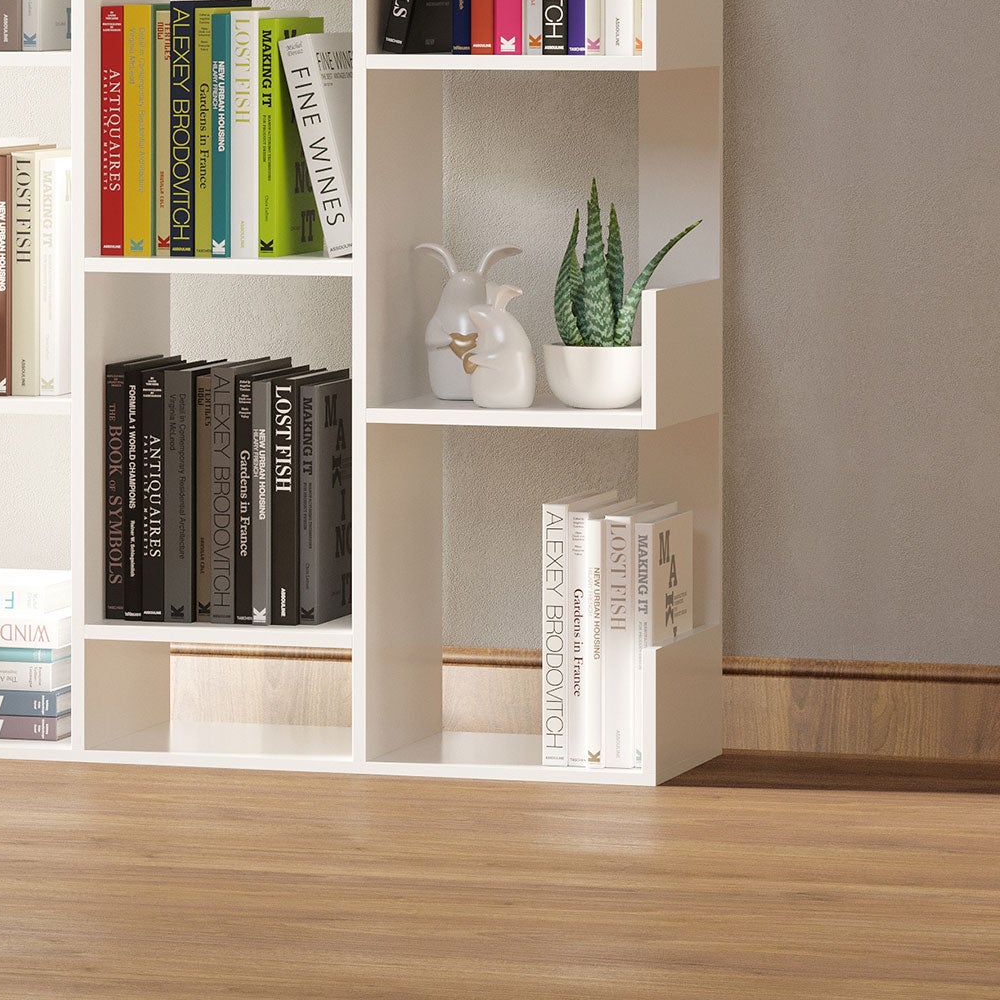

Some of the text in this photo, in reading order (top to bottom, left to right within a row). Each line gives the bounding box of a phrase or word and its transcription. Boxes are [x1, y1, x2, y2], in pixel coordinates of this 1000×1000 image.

[235, 18, 250, 124] LOST FISH
[261, 30, 272, 108] MAKING IT
[108, 68, 121, 192] ANTIQUAIRES
[172, 7, 190, 241] ALEXEY BRODOVITCH
[199, 83, 210, 189] Gardens in France
[291, 67, 322, 127] FINE
[309, 136, 345, 226] WINES
[16, 159, 31, 264] LOST FISH
[128, 385, 136, 423] FORMULA
[128, 431, 136, 461] WORLD
[275, 385, 292, 492] LOST FISH
[302, 397, 313, 476] MAKING IT
[109, 403, 123, 584] THE BOOK OF SYMBOLS
[128, 462, 136, 509] CHAMPIONS
[148, 434, 161, 558] ANTIQUAIRES
[213, 374, 230, 607] ALEXEY BRODOVITCH
[240, 449, 250, 556] Gardens in France
[258, 428, 266, 520] NEW URBAN HOUSING
[610, 523, 627, 631] LOST FISH
[638, 535, 648, 614] MAKING IT
[546, 511, 563, 749] ALEXEY BRODOVITCH
[573, 588, 584, 697] Gardens in France
